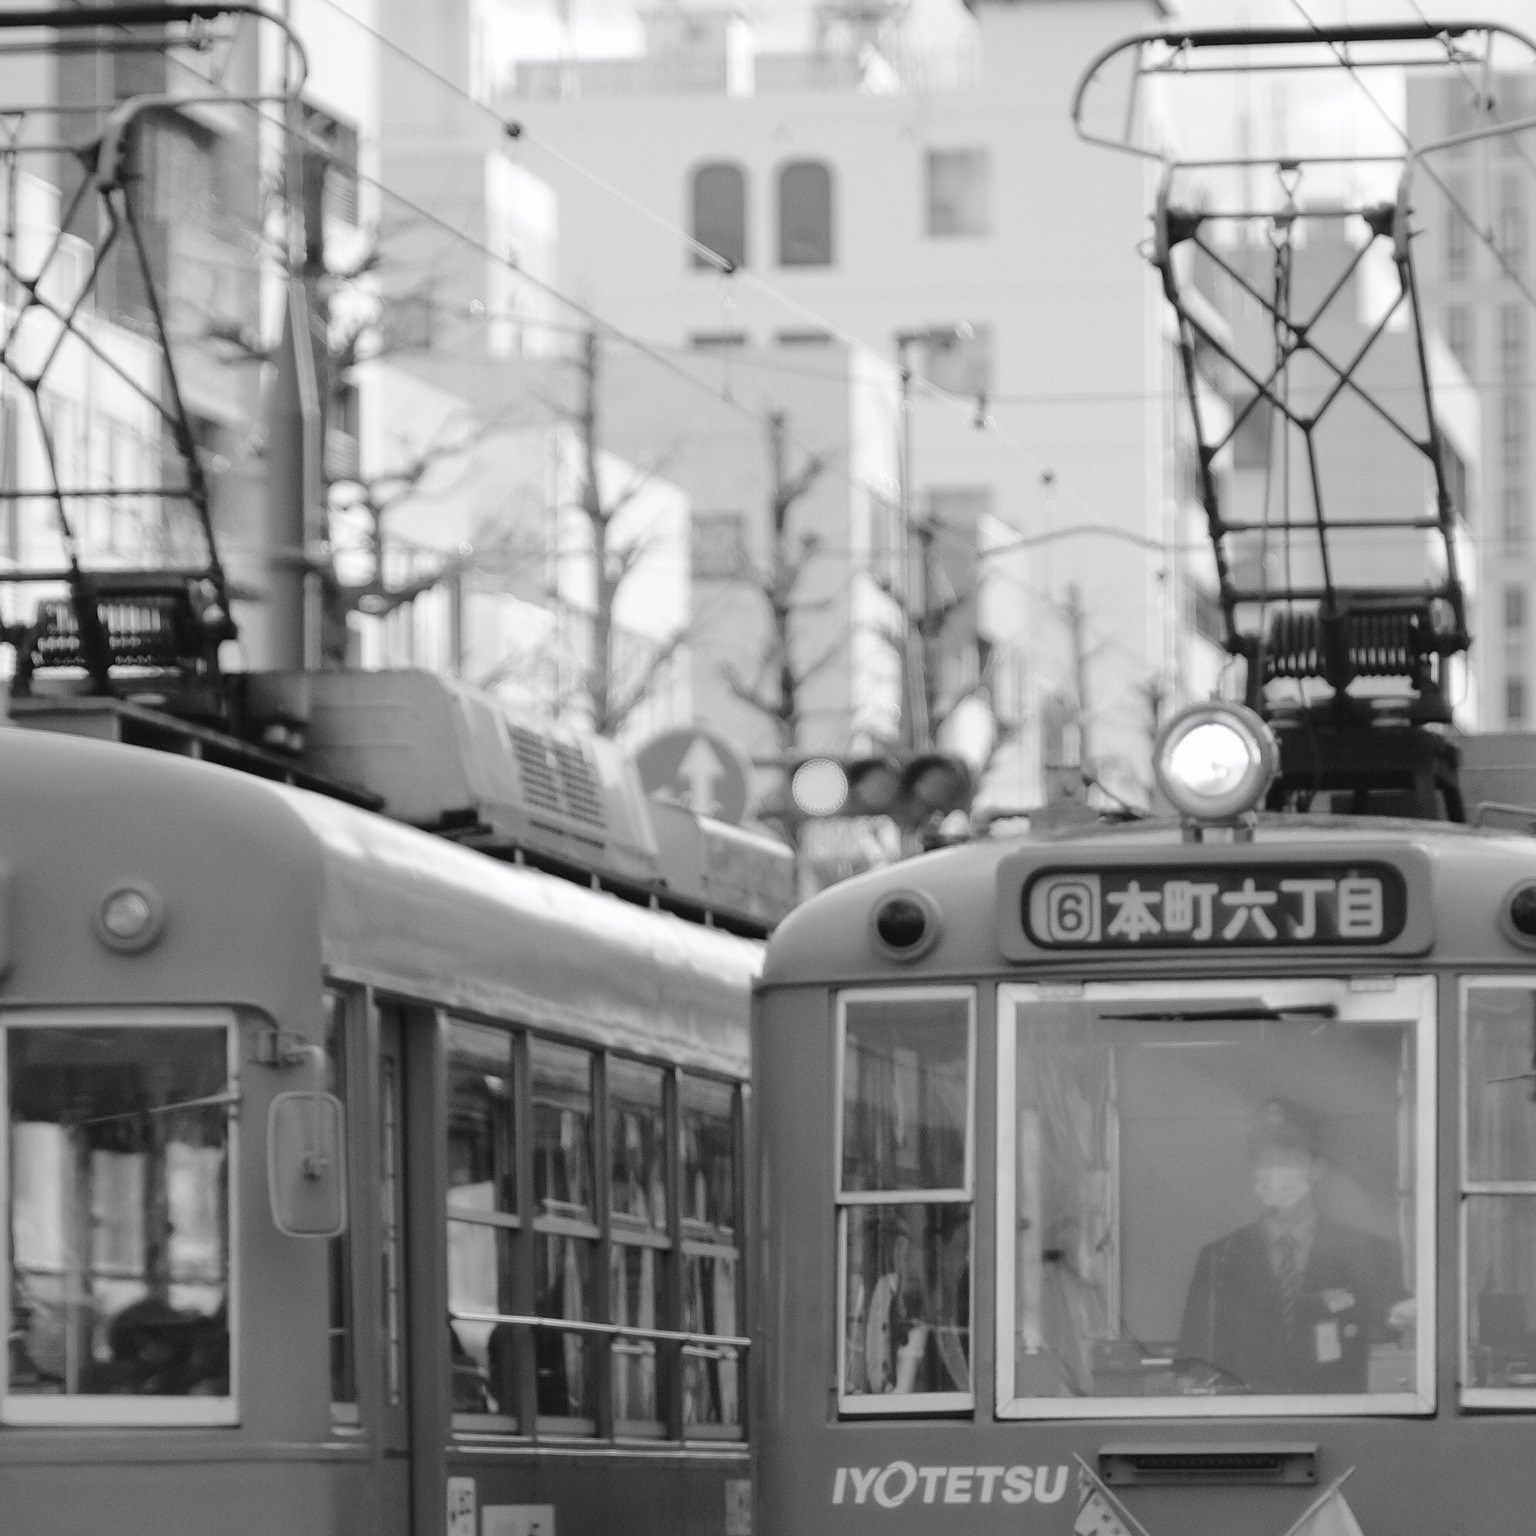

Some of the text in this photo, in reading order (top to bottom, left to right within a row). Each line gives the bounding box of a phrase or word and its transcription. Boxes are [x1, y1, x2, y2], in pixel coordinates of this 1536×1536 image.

[1105, 876, 1384, 942] 本町六丁目
[831, 1459, 1070, 1509] IYOTETSU
